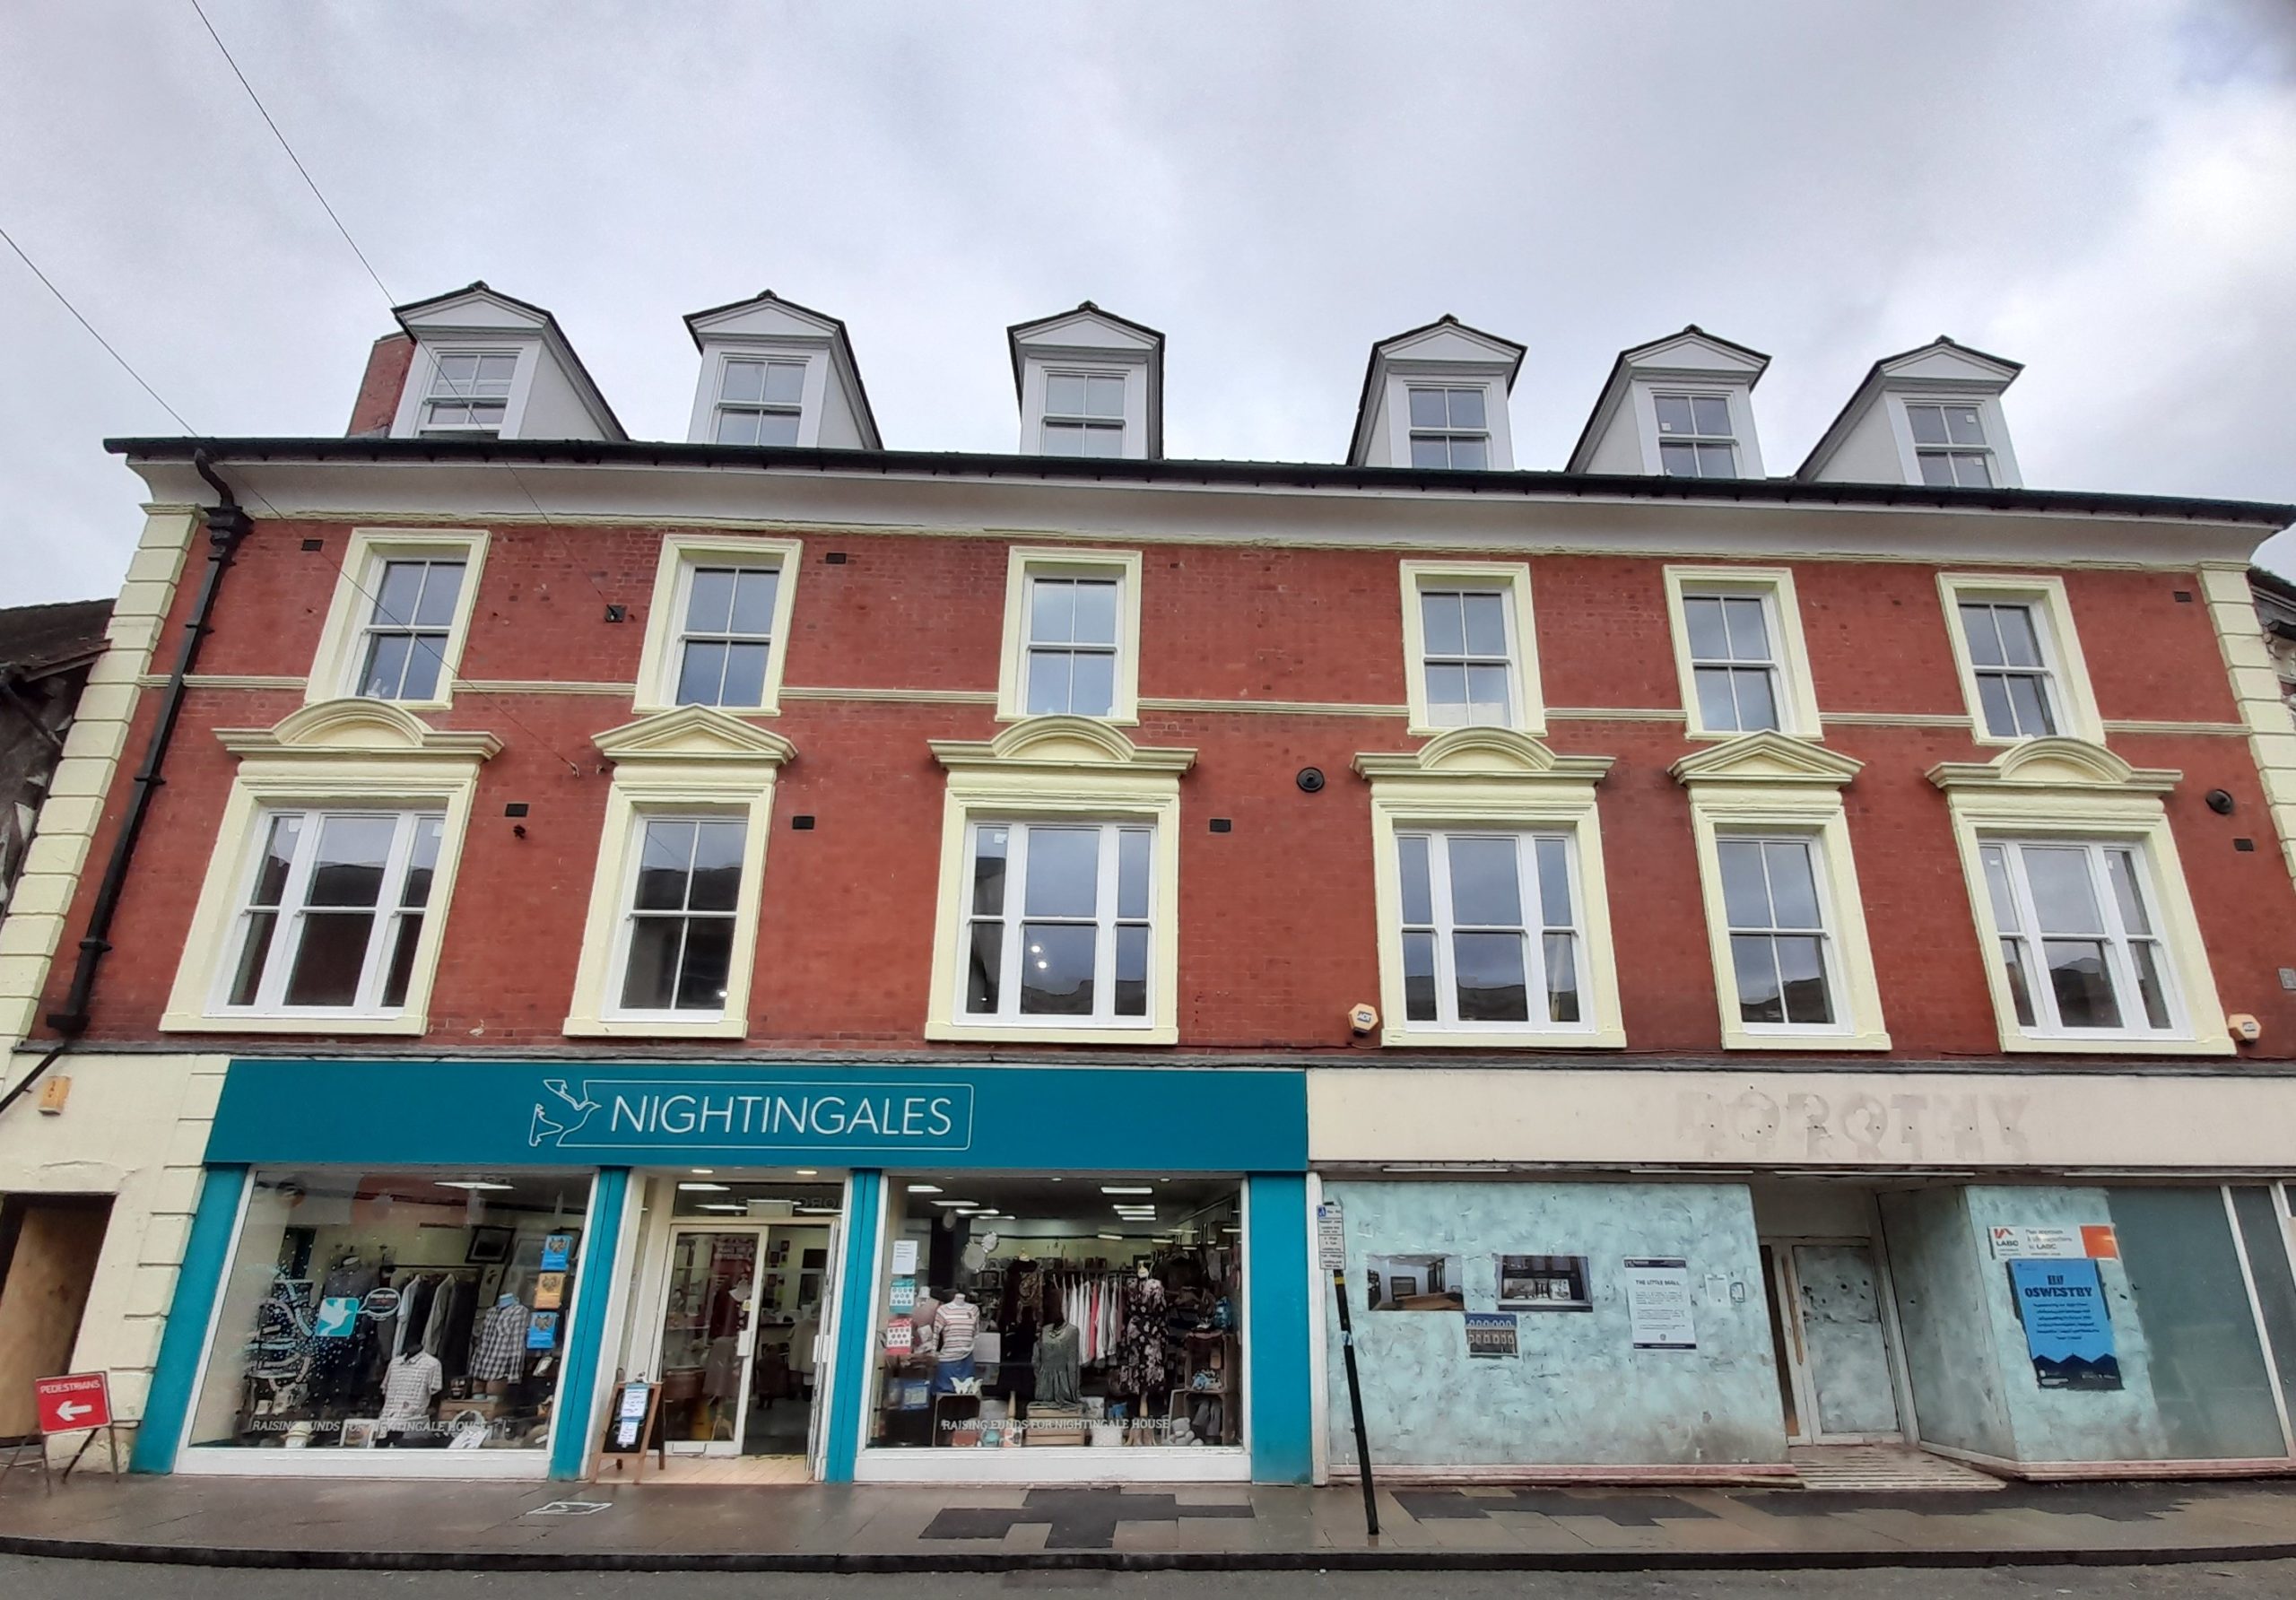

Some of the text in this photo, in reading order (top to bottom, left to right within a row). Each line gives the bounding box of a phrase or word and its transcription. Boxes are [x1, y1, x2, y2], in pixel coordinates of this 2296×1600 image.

[611, 1094, 952, 1135] NIGHTINGALES
[2024, 1286, 2092, 1298] OSWESTRY
[40, 1380, 100, 1393] PEDESTRIANS
[303, 1421, 340, 1431] UNDS
[943, 1418, 1170, 1430] RAISING FUNDS FOR NIGHTINGALE HOUSE
